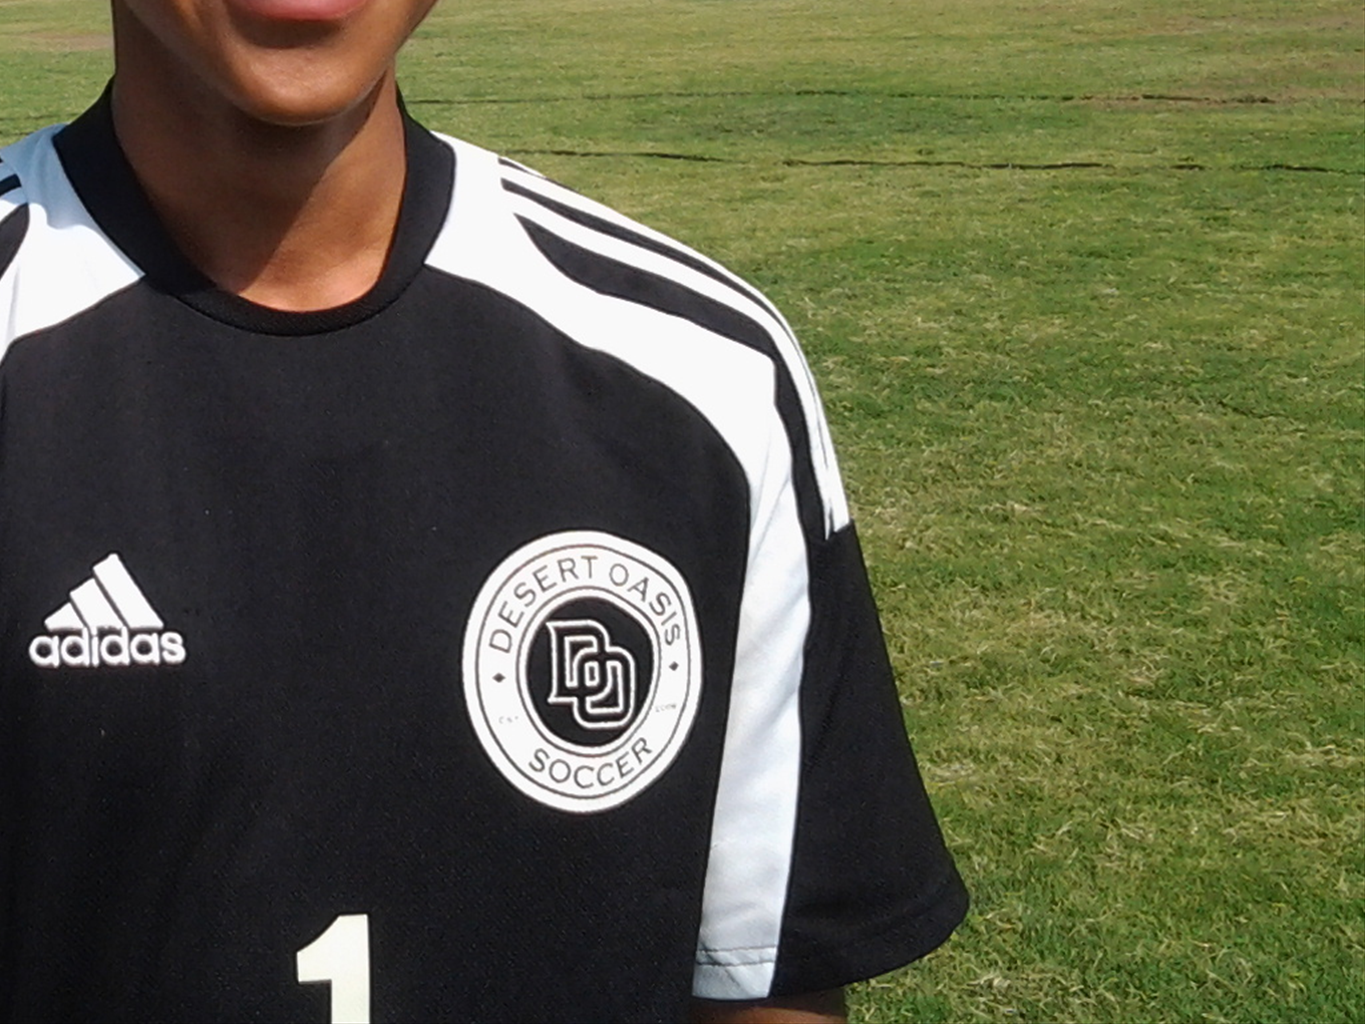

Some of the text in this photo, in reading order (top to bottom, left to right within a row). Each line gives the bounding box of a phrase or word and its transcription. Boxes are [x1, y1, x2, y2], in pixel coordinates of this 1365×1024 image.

[489, 556, 680, 653] DESERT OASIS
[29, 626, 186, 667] adidas
[529, 737, 652, 789] SOCCER
[296, 913, 370, 1024] 1
